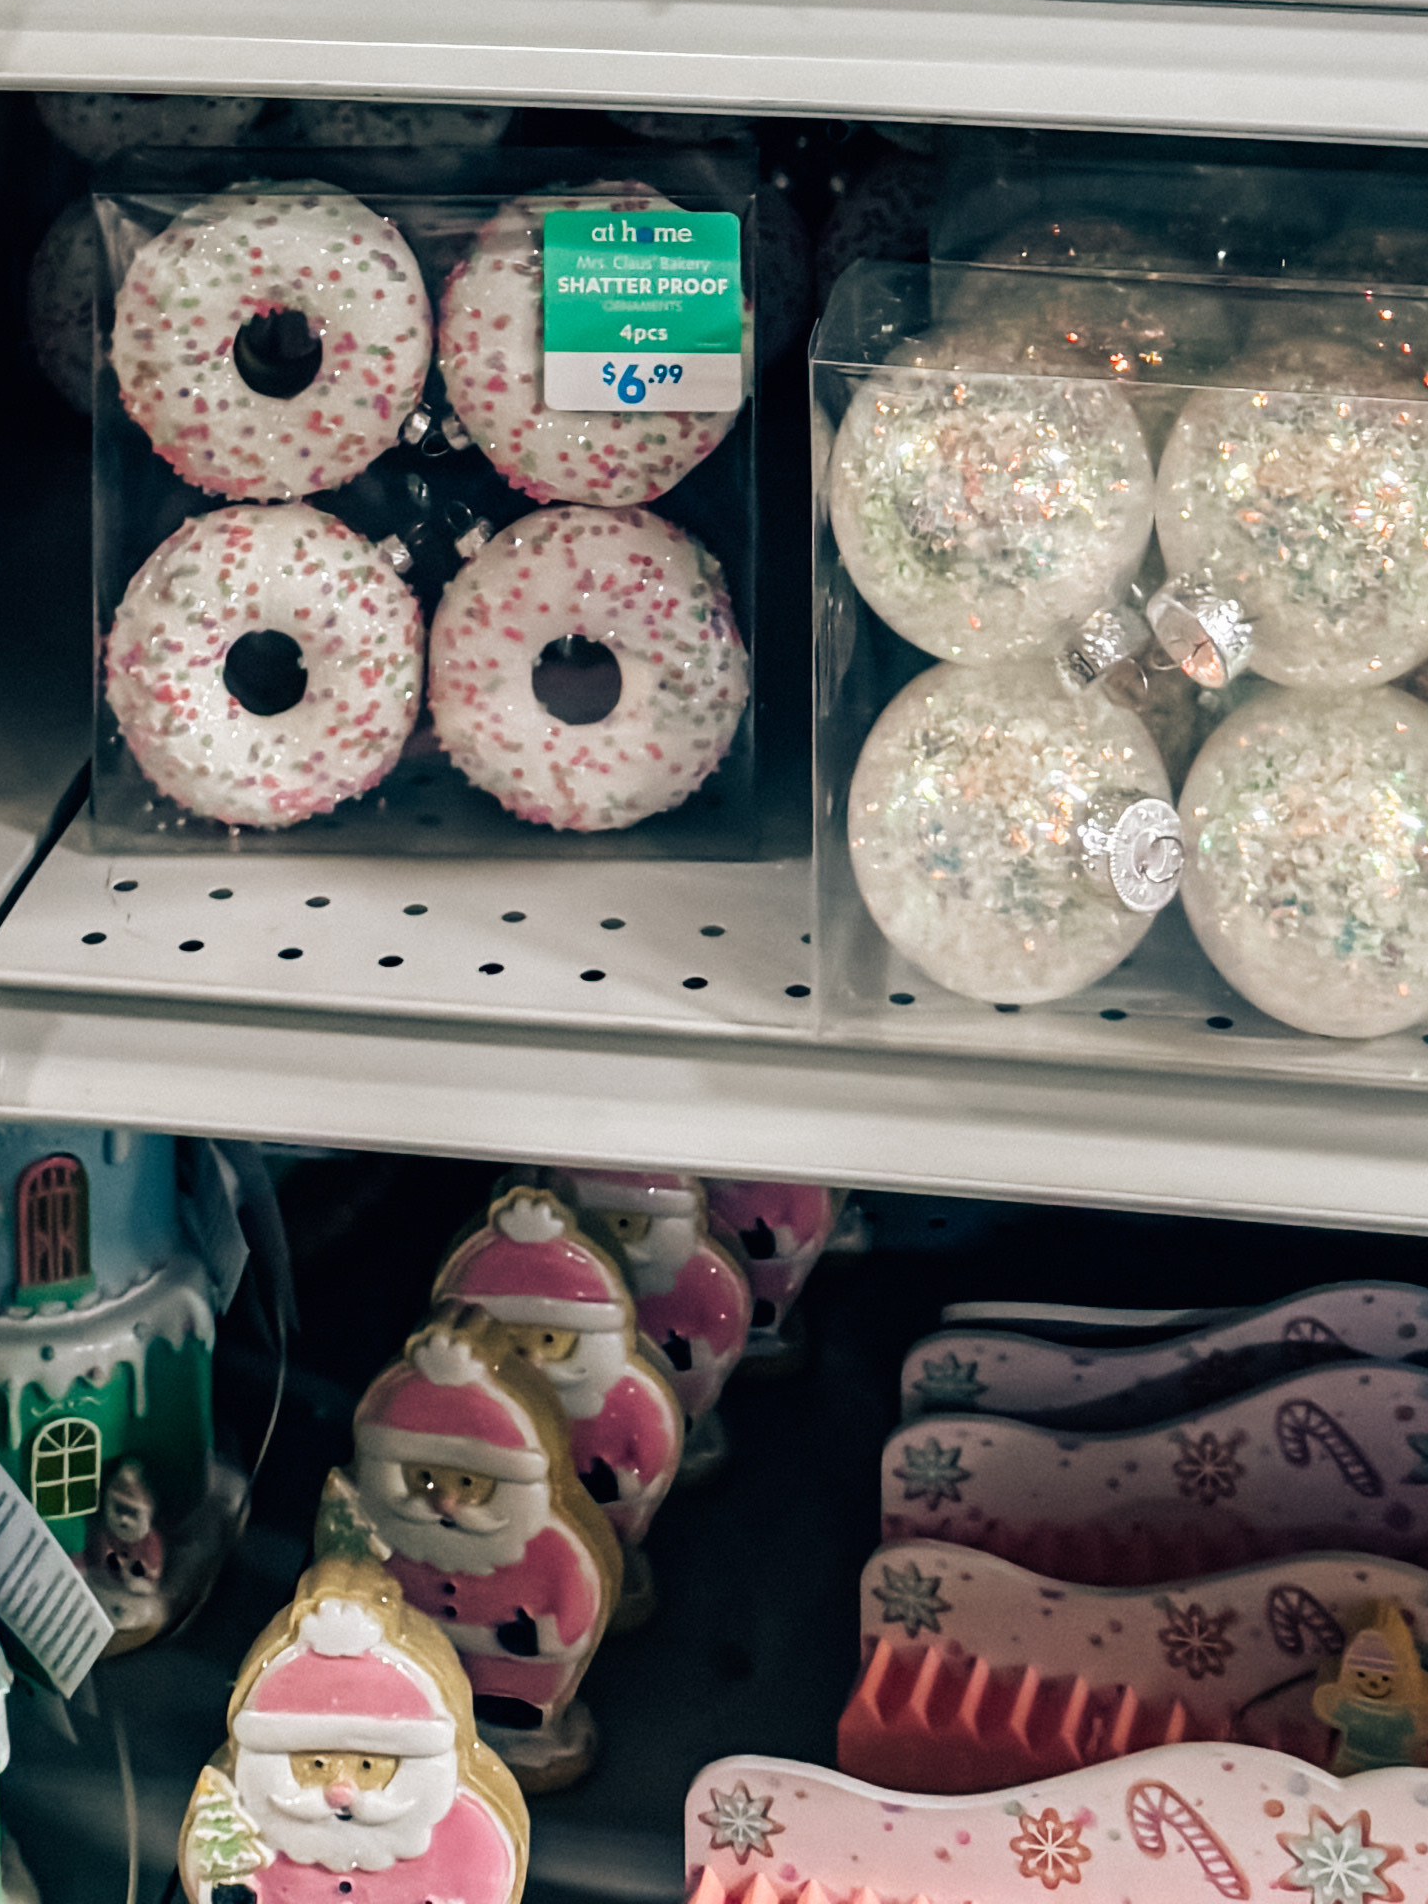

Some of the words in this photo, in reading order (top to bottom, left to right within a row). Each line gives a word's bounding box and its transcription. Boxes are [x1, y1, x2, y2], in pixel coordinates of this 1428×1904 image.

[591, 223, 615, 243] at
[557, 276, 652, 295] SHATTER
[657, 277, 729, 296] PROOF
[619, 323, 669, 345] 4pcs
[602, 361, 684, 405] $6.99
